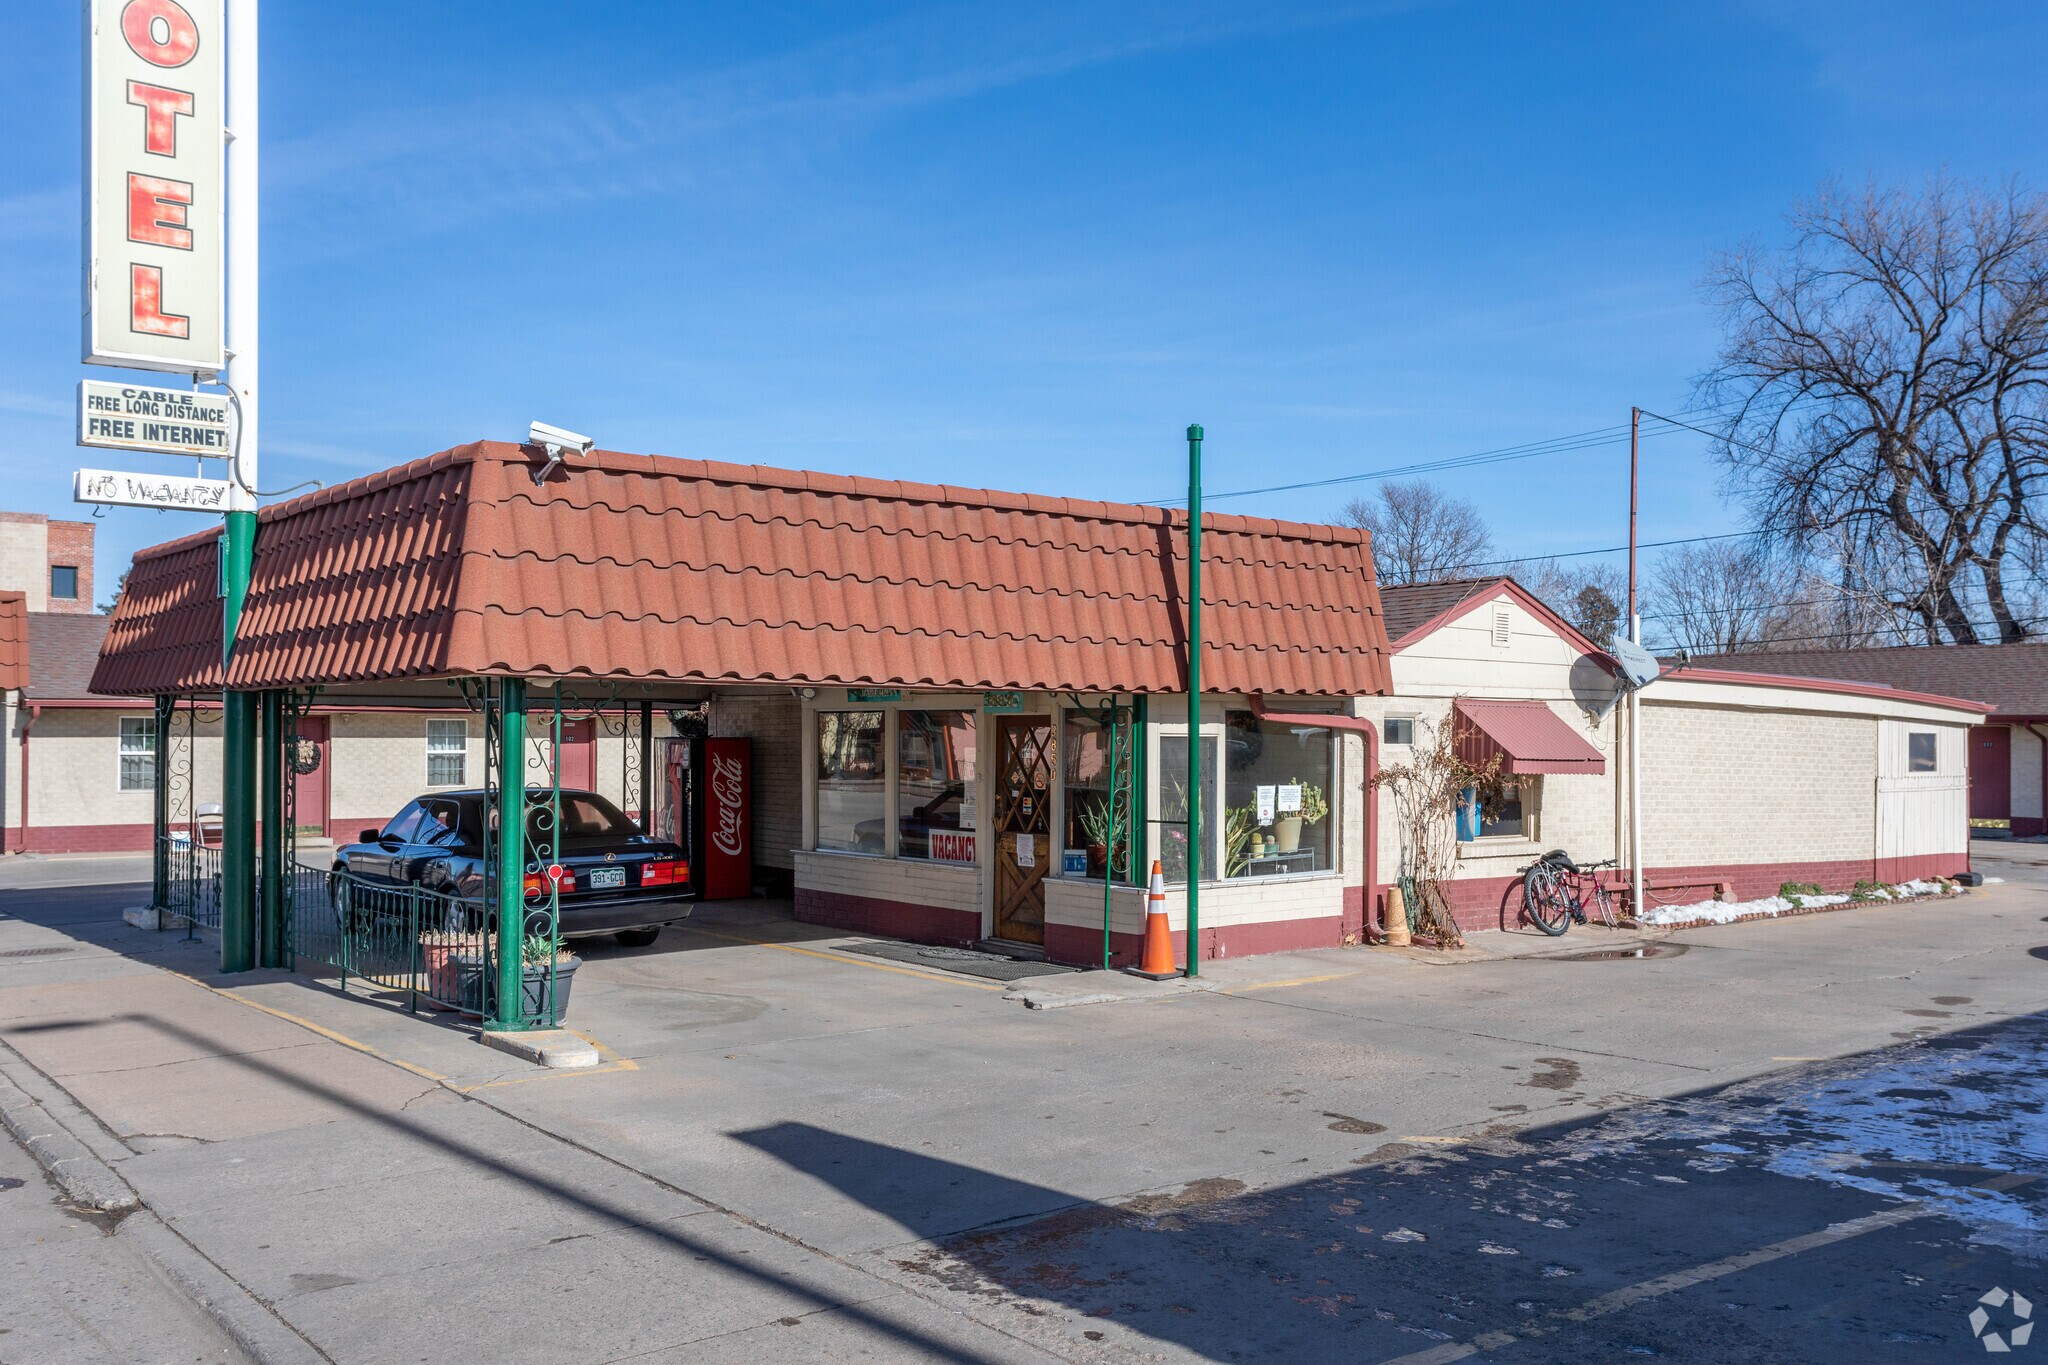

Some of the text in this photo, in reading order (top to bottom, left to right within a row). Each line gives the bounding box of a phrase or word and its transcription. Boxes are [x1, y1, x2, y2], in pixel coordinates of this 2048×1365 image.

[119, 0, 200, 340] OTEL
[88, 395, 225, 423] FREE LONG DISTANCE
[121, 388, 194, 406] CABLE
[89, 417, 226, 447] FREE INTERNET
[87, 475, 118, 499] NO
[712, 752, 742, 856] Coca-Cola
[931, 834, 976, 863] VACANCY
